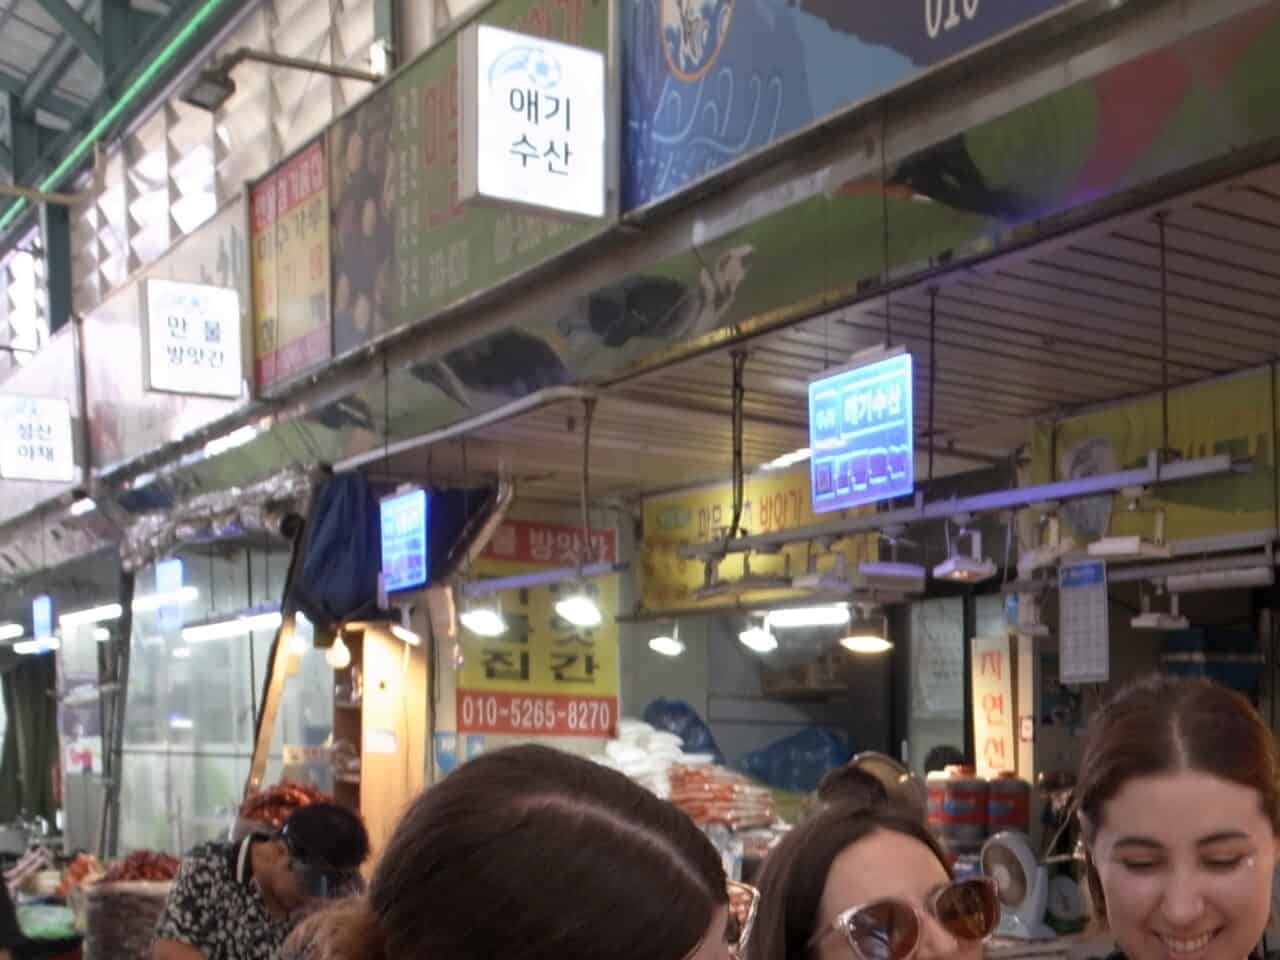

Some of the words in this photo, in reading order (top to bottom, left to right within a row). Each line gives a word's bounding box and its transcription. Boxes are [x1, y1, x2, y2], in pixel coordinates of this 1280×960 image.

[509, 88, 571, 131] 애기
[509, 133, 573, 176] 수산
[463, 697, 609, 729] 010-5265-8270
